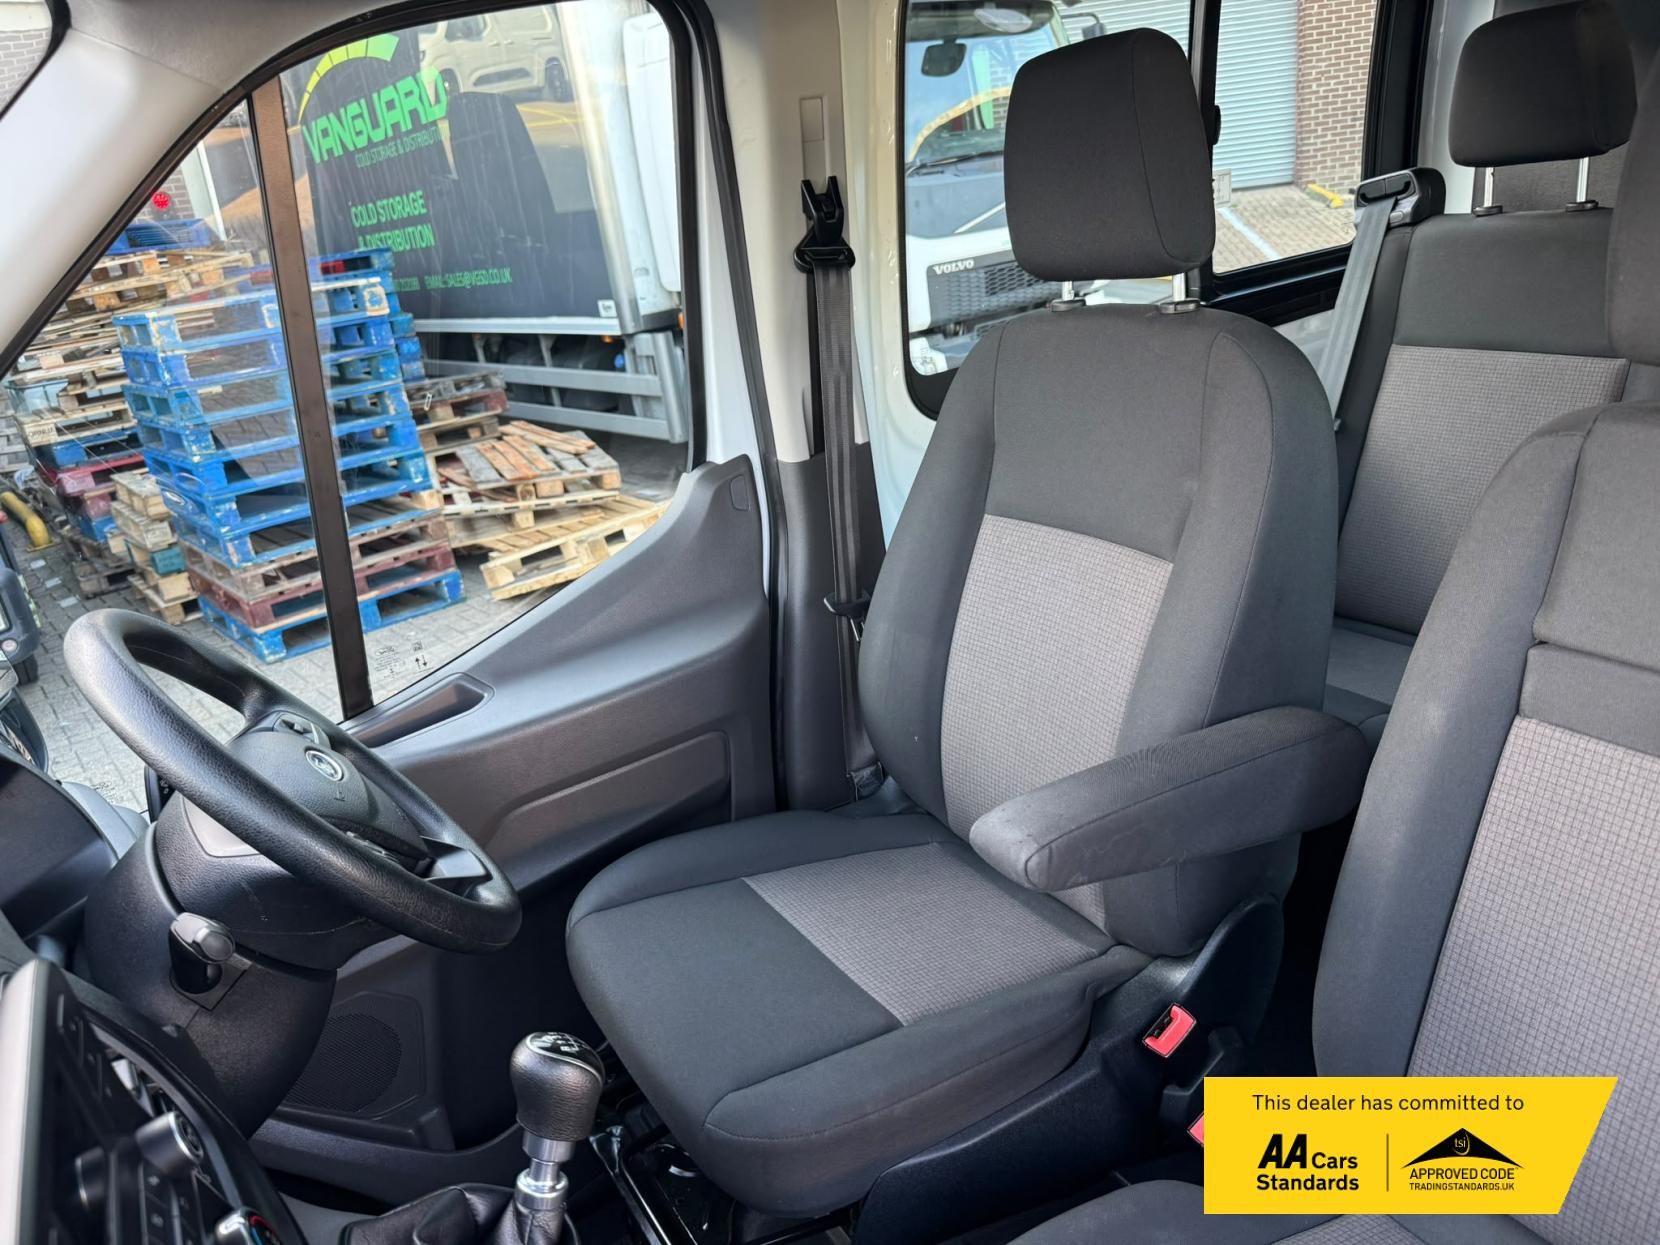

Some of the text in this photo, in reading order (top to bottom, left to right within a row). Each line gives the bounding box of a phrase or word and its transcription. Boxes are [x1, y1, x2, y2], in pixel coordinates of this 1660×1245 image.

[302, 66, 448, 164] VANGUARD
[351, 189, 427, 228] COLD STORAGE
[365, 223, 436, 252] DISTRIBUTION
[932, 258, 975, 275] VOLVO
